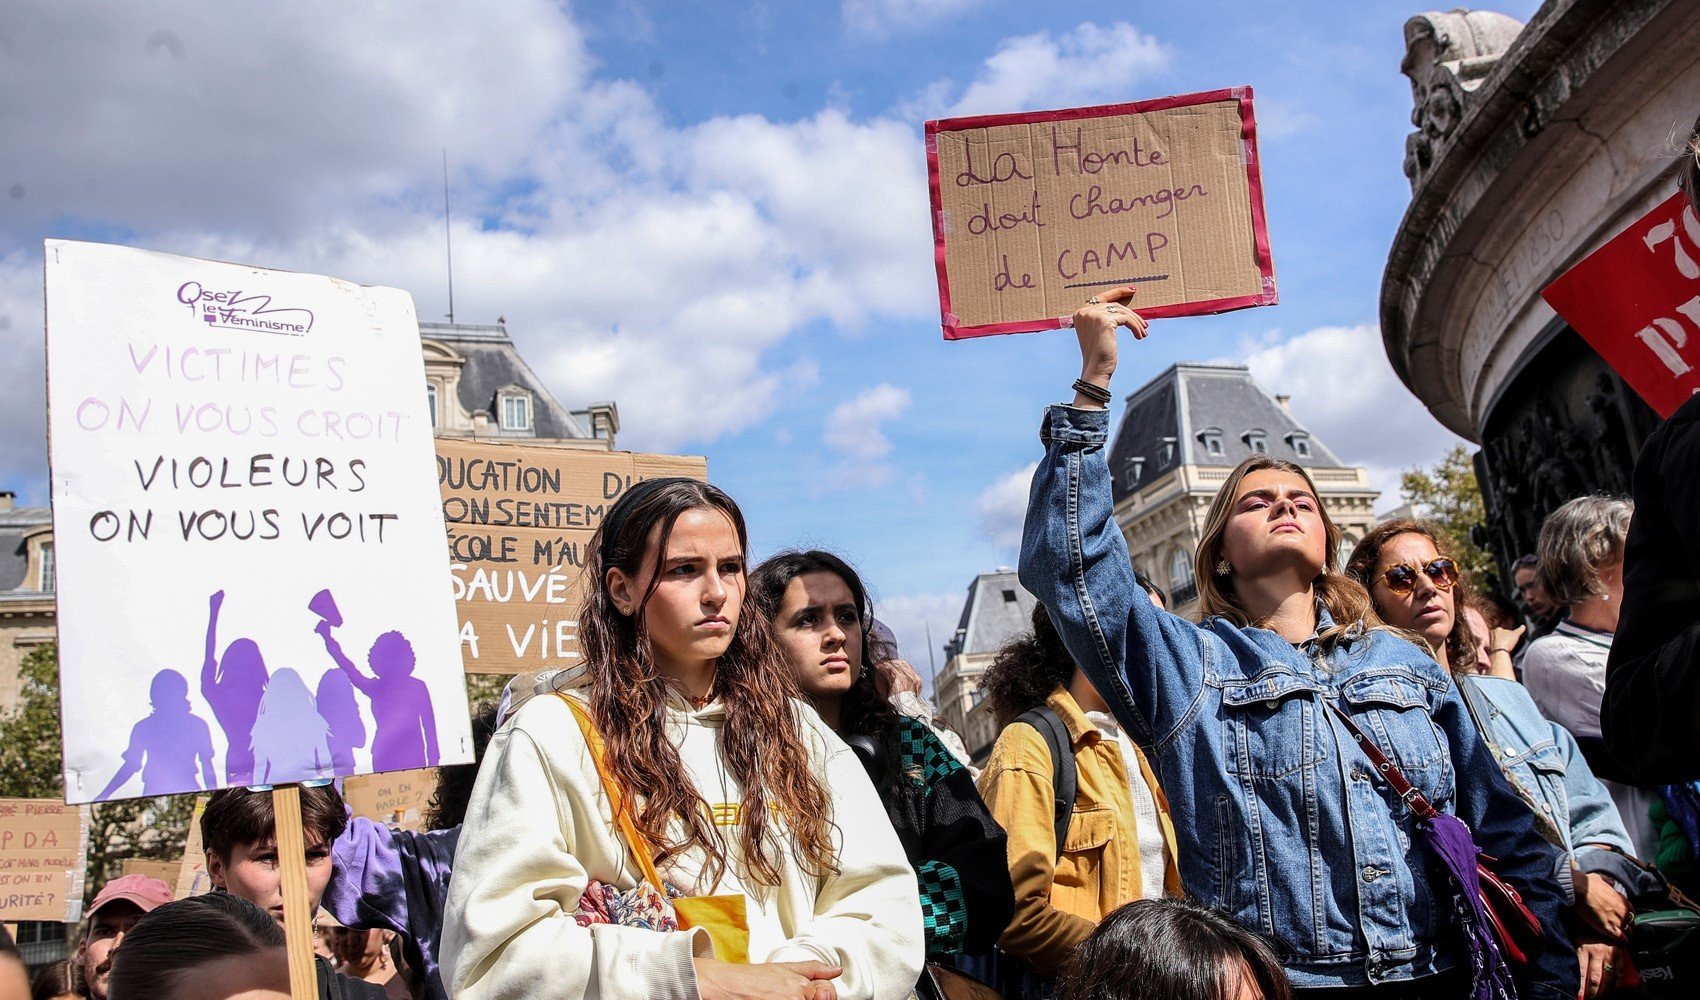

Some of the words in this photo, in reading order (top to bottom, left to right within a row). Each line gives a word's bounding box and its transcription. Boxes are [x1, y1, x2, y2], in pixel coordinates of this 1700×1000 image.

[1051, 126, 1170, 176] Honte
[968, 191, 1046, 235] doit
[994, 255, 1036, 291] de
[1057, 232, 1169, 280] CAMP
[202, 303, 217, 313] le
[128, 342, 347, 392] VICTIMES
[76, 396, 152, 433] ON
[175, 402, 279, 438] VOUS
[297, 408, 411, 443] CROIT
[134, 453, 367, 493] VIOLEURS
[89, 509, 153, 543] ON
[179, 509, 281, 543] VOUS
[302, 512, 398, 543] VOIT
[443, 497, 610, 527] ONSENTEM
[450, 563, 568, 603] SAUVÉ
[13, 874, 31, 885] ON
[36, 874, 53, 883] EN
